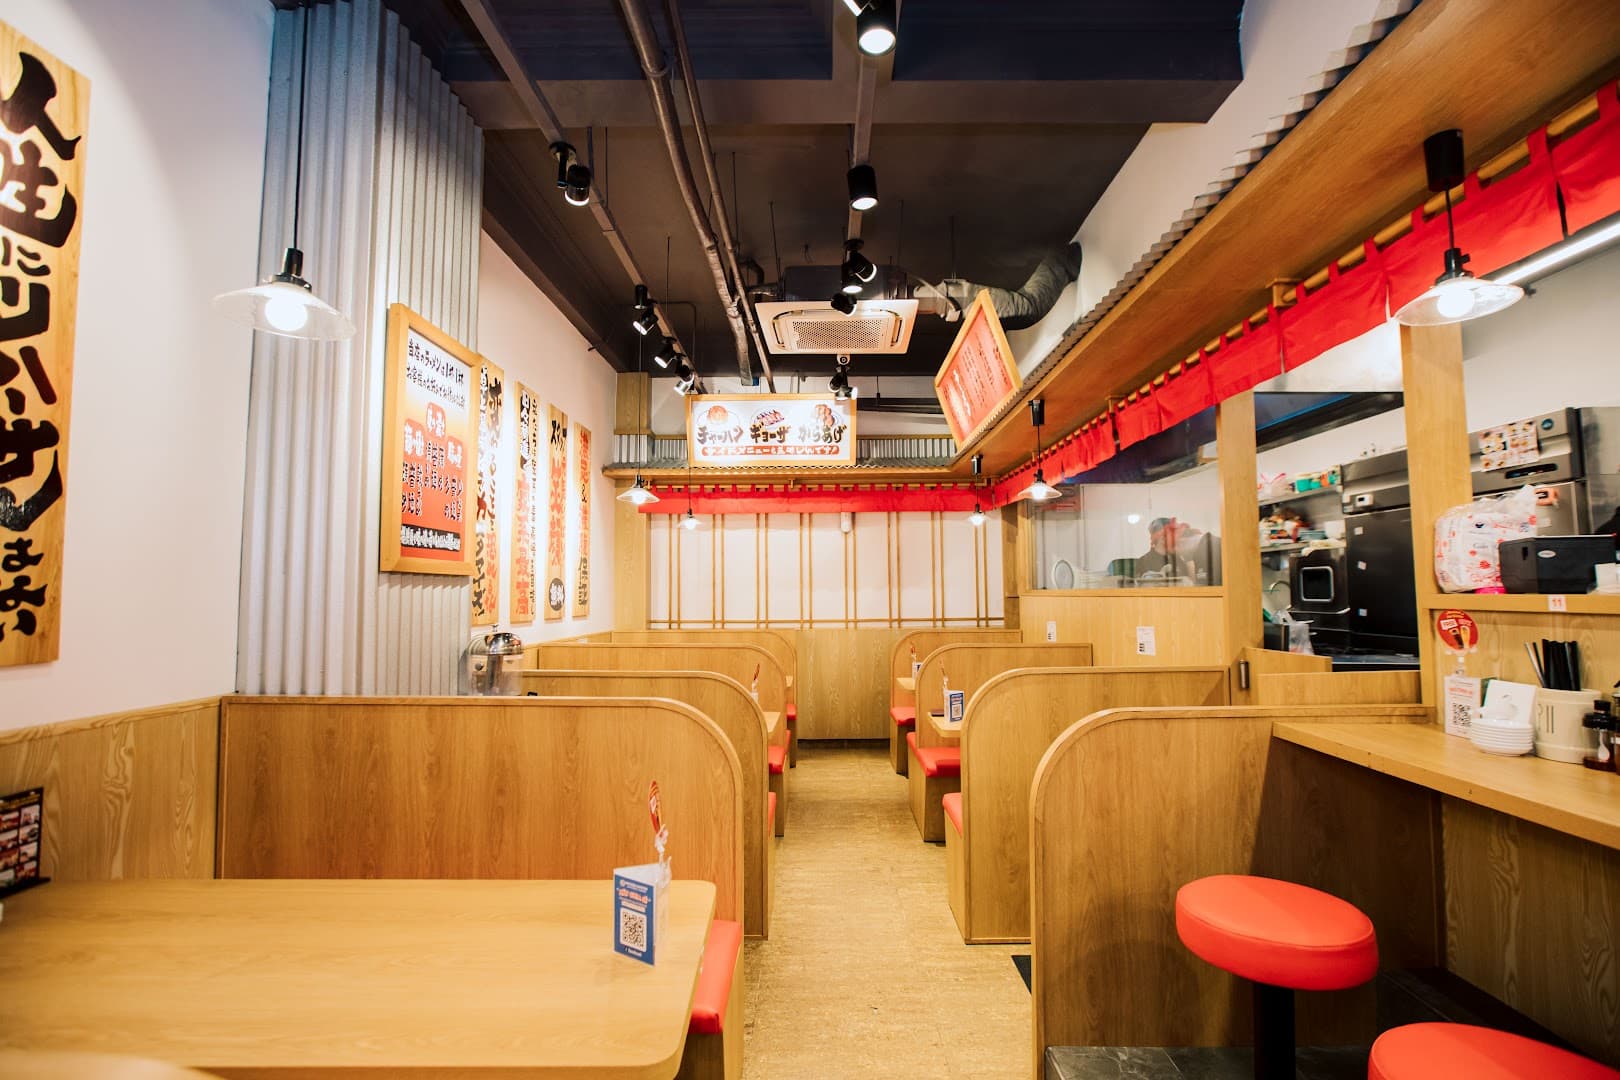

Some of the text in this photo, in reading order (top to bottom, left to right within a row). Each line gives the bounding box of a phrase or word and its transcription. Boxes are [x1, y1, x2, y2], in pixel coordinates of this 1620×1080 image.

[697, 425, 744, 445] チャーハン
[750, 423, 790, 443] ギョーザ
[797, 424, 848, 444] からあげ
[1551, 598, 1562, 608] 11
